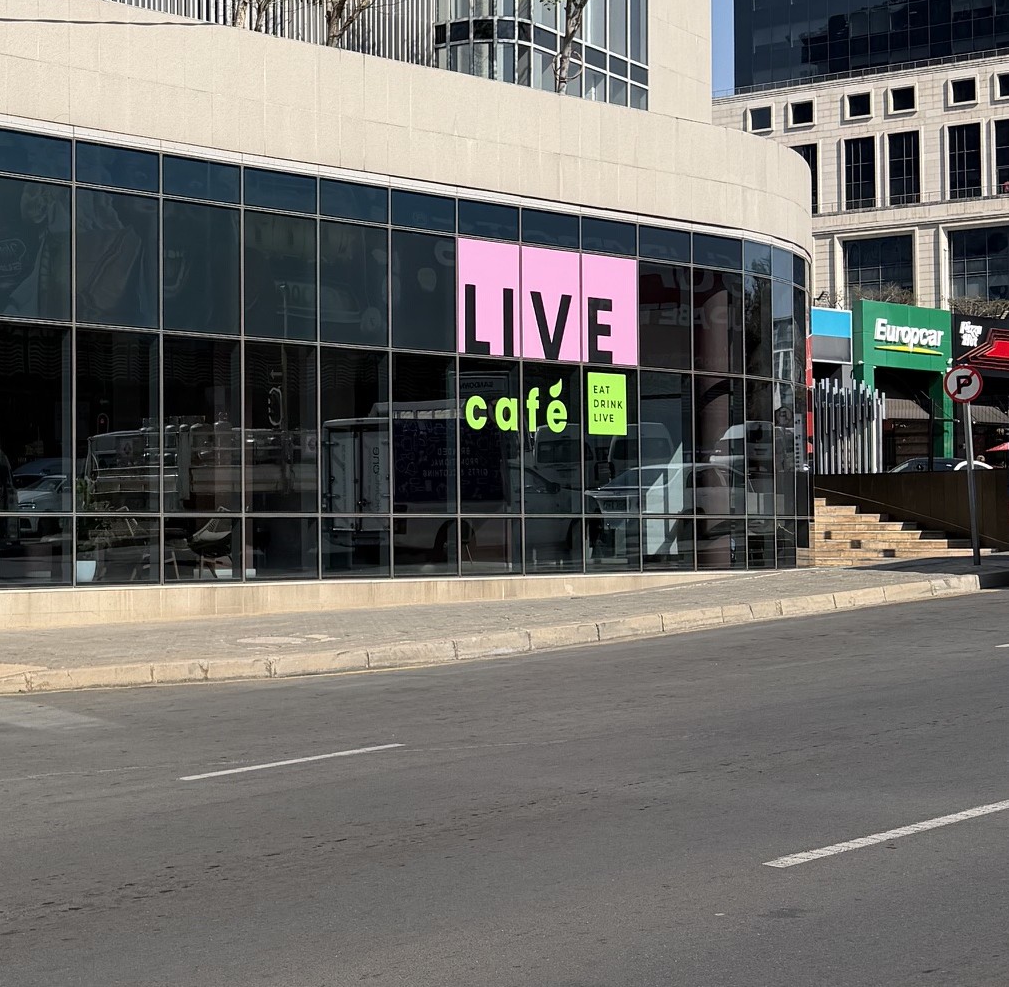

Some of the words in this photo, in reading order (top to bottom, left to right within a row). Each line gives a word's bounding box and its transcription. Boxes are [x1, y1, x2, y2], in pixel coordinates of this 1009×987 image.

[465, 284, 613, 364] LIVE
[874, 318, 944, 350] Europcar
[593, 385, 611, 395] EAT
[465, 378, 568, 433] café
[593, 399, 623, 410] DRINK
[593, 414, 615, 423] LIVE
